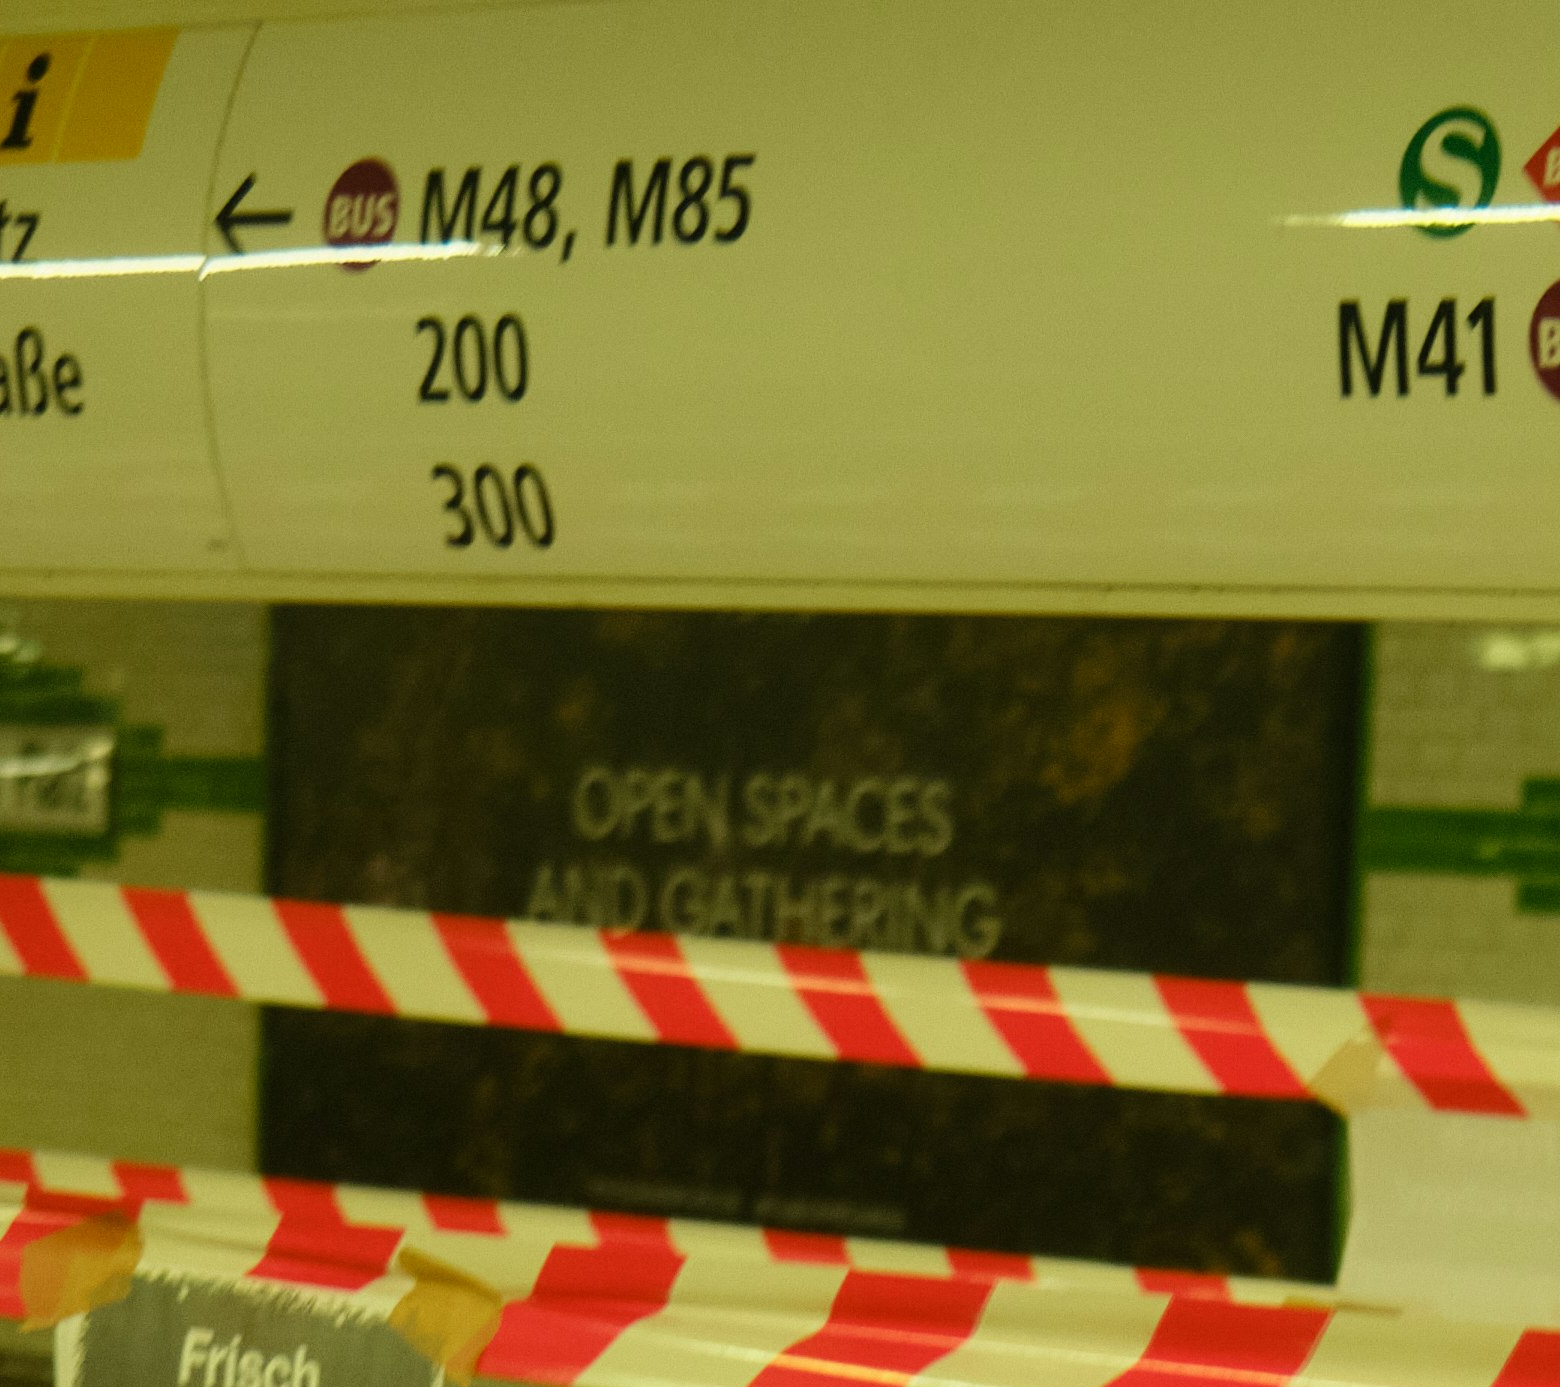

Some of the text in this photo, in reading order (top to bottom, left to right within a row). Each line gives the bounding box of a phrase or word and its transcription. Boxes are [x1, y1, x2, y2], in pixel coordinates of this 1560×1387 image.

[328, 191, 397, 241] BUS
[418, 153, 757, 265] M48, M85
[415, 312, 530, 405] 200
[1338, 295, 1497, 399] M41
[431, 462, 555, 549] 300
[571, 765, 956, 858] OPEN SPACES
[526, 862, 1005, 959] AND GATHERING
